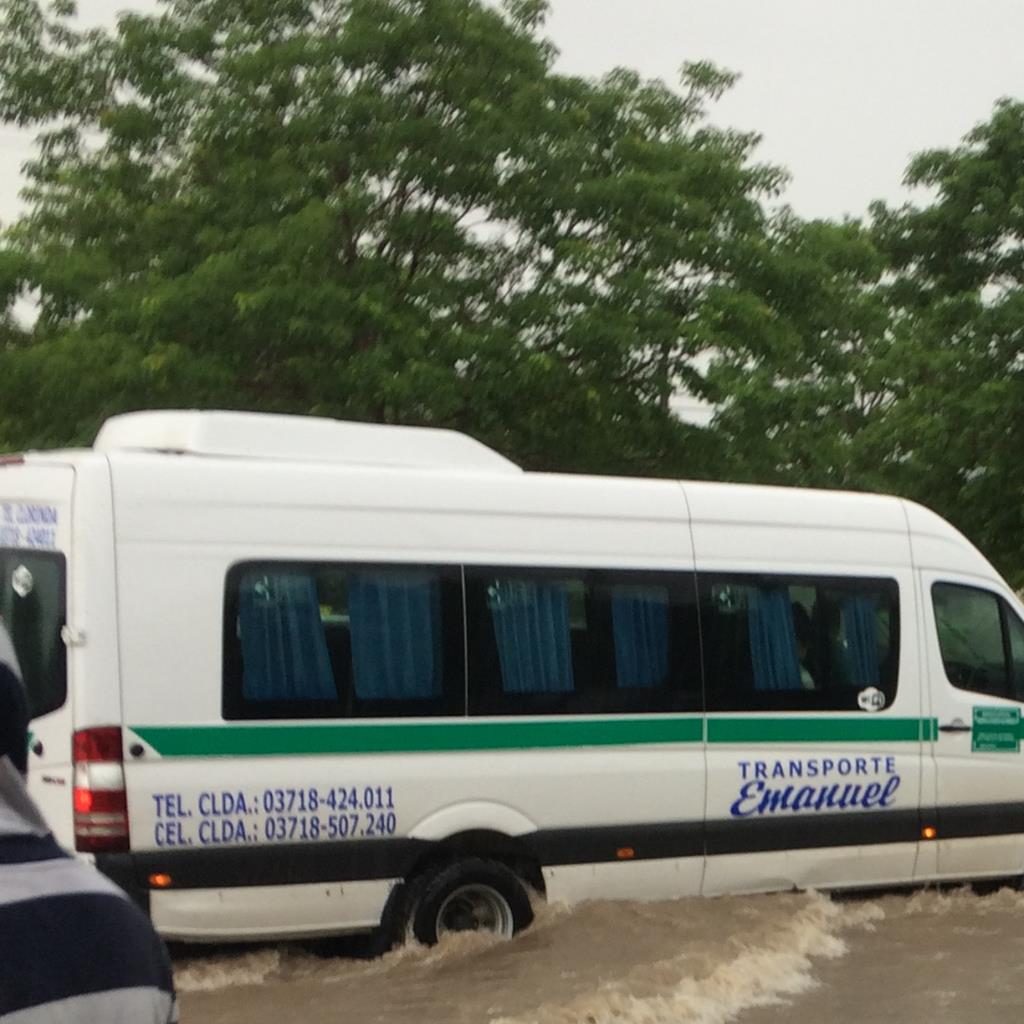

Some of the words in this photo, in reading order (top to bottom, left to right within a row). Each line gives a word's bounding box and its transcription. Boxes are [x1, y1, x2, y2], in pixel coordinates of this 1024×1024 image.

[738, 756, 896, 779] TRANSPORTE
[152, 794, 192, 818] TEL.
[198, 790, 258, 817] CLDA.:
[263, 786, 395, 813] 03718-424.011
[730, 775, 901, 817] Emanuel
[154, 821, 193, 846] CEL.
[198, 819, 259, 845] CLDA.:
[264, 812, 397, 841] 03718-507.240
